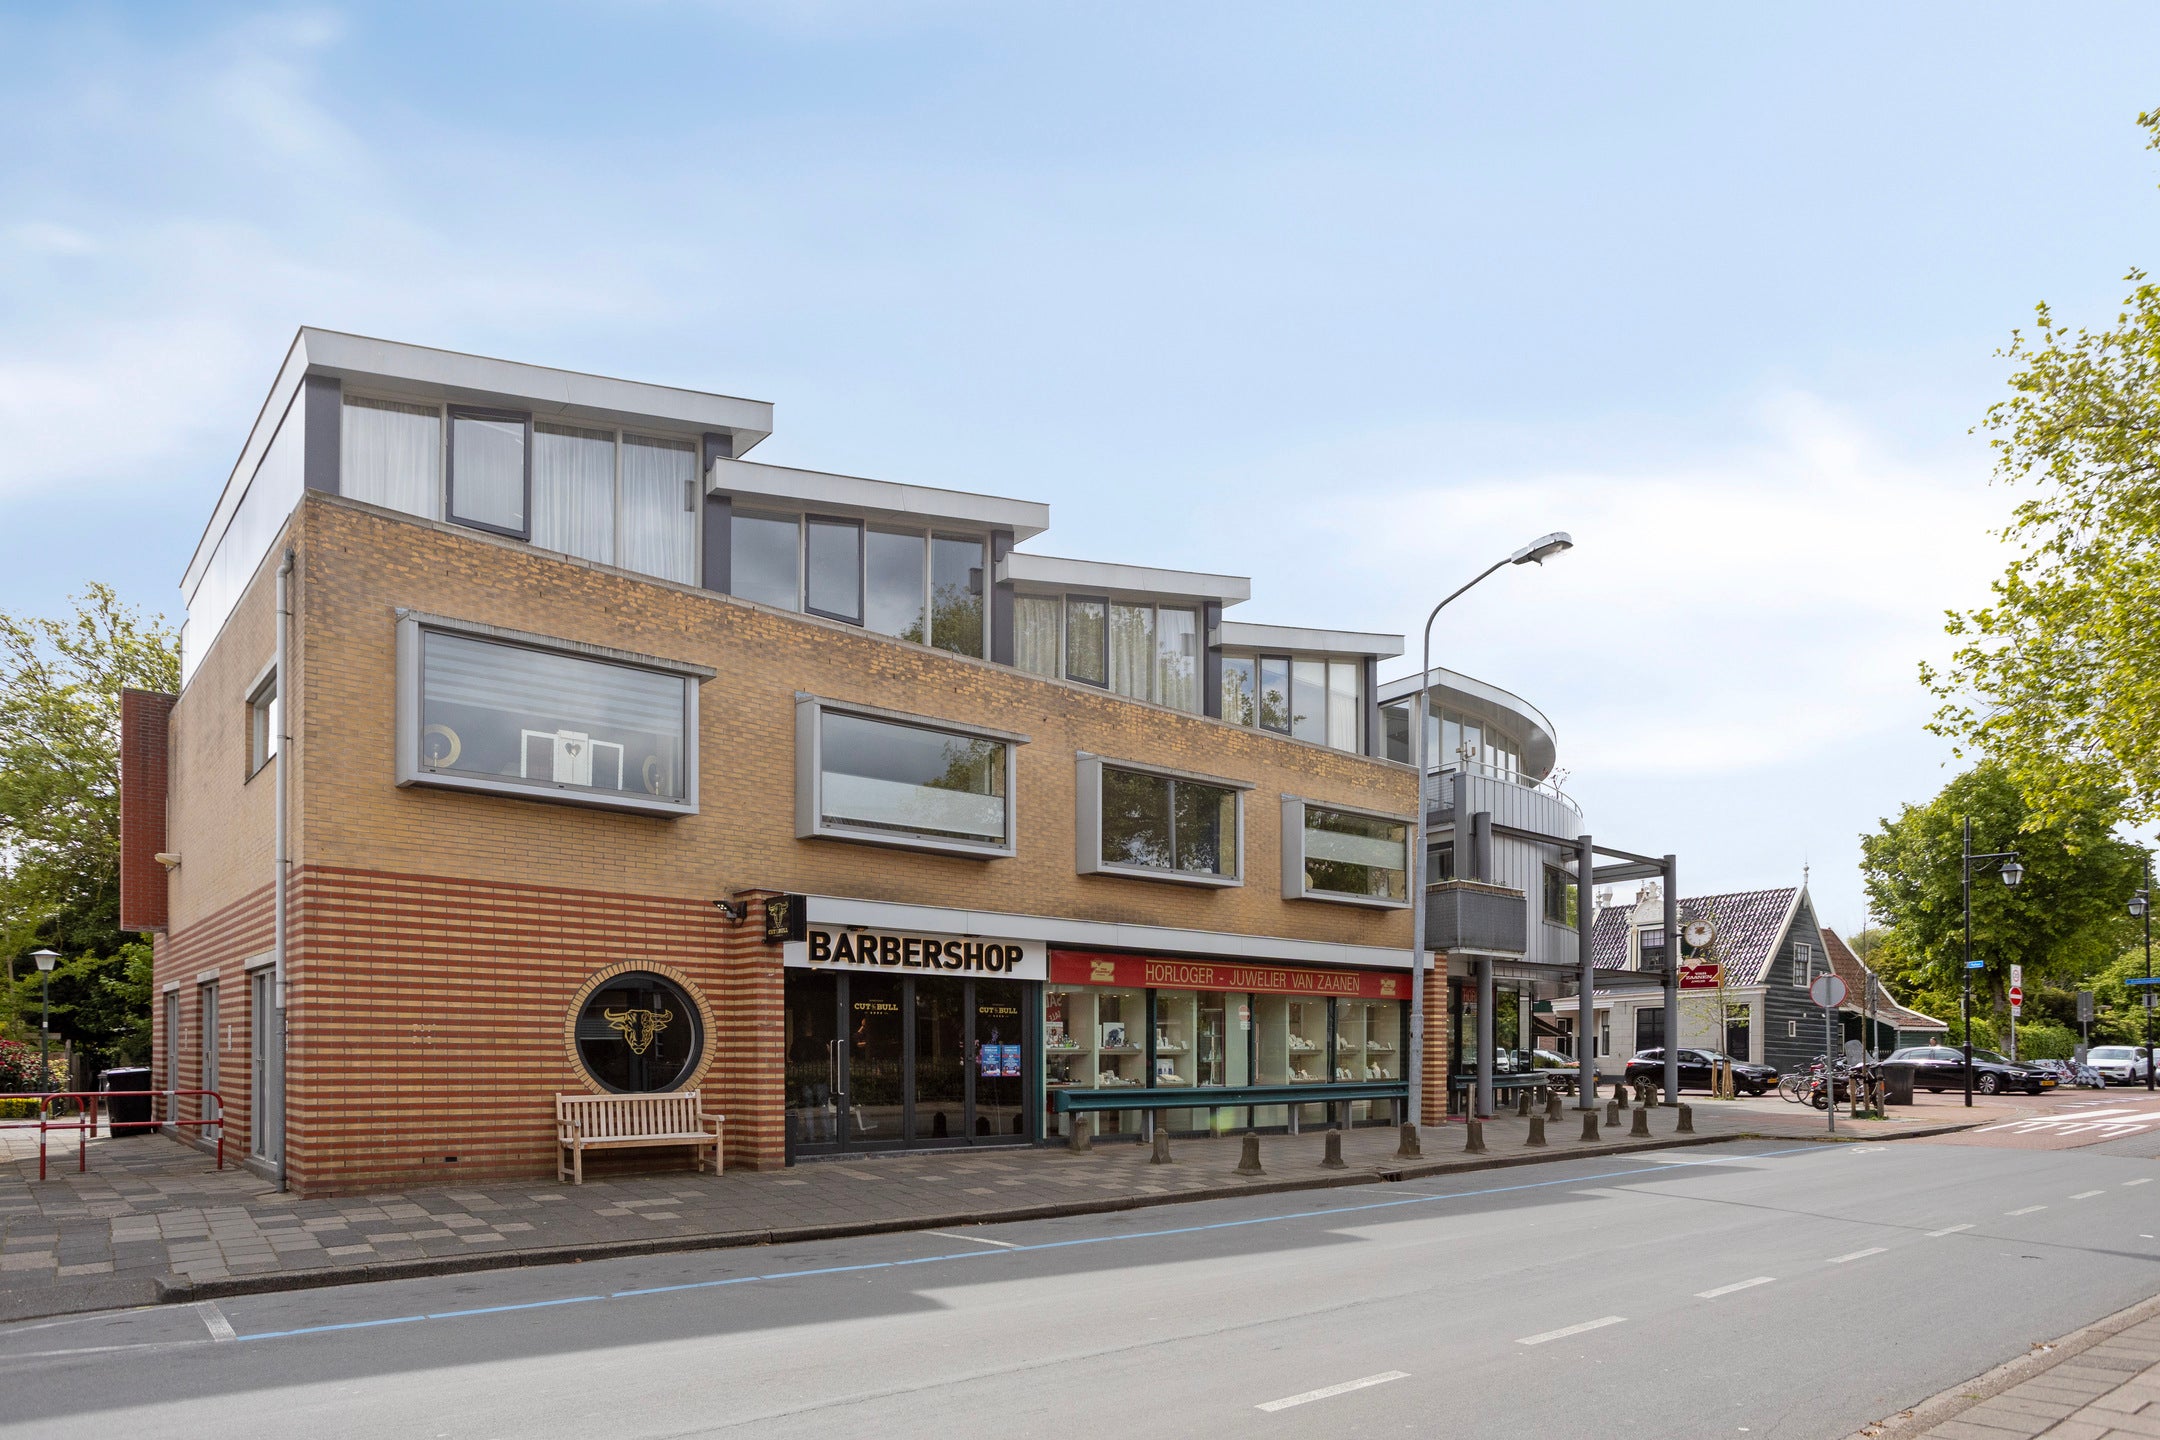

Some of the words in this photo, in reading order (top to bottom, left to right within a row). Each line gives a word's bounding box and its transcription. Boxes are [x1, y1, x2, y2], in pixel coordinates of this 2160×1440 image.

[808, 930, 1024, 973] BARBERSHOP
[1145, 963, 1214, 985] HORLOGER
[1229, 969, 1287, 989] JUWELIER
[1291, 973, 1314, 990] VAN
[1317, 974, 1360, 992] ZAANEN
[854, 1002, 871, 1010] CUT
[876, 1003, 899, 1011] BULL
[979, 1006, 994, 1014] CUT
[998, 1007, 1018, 1015] BULL
